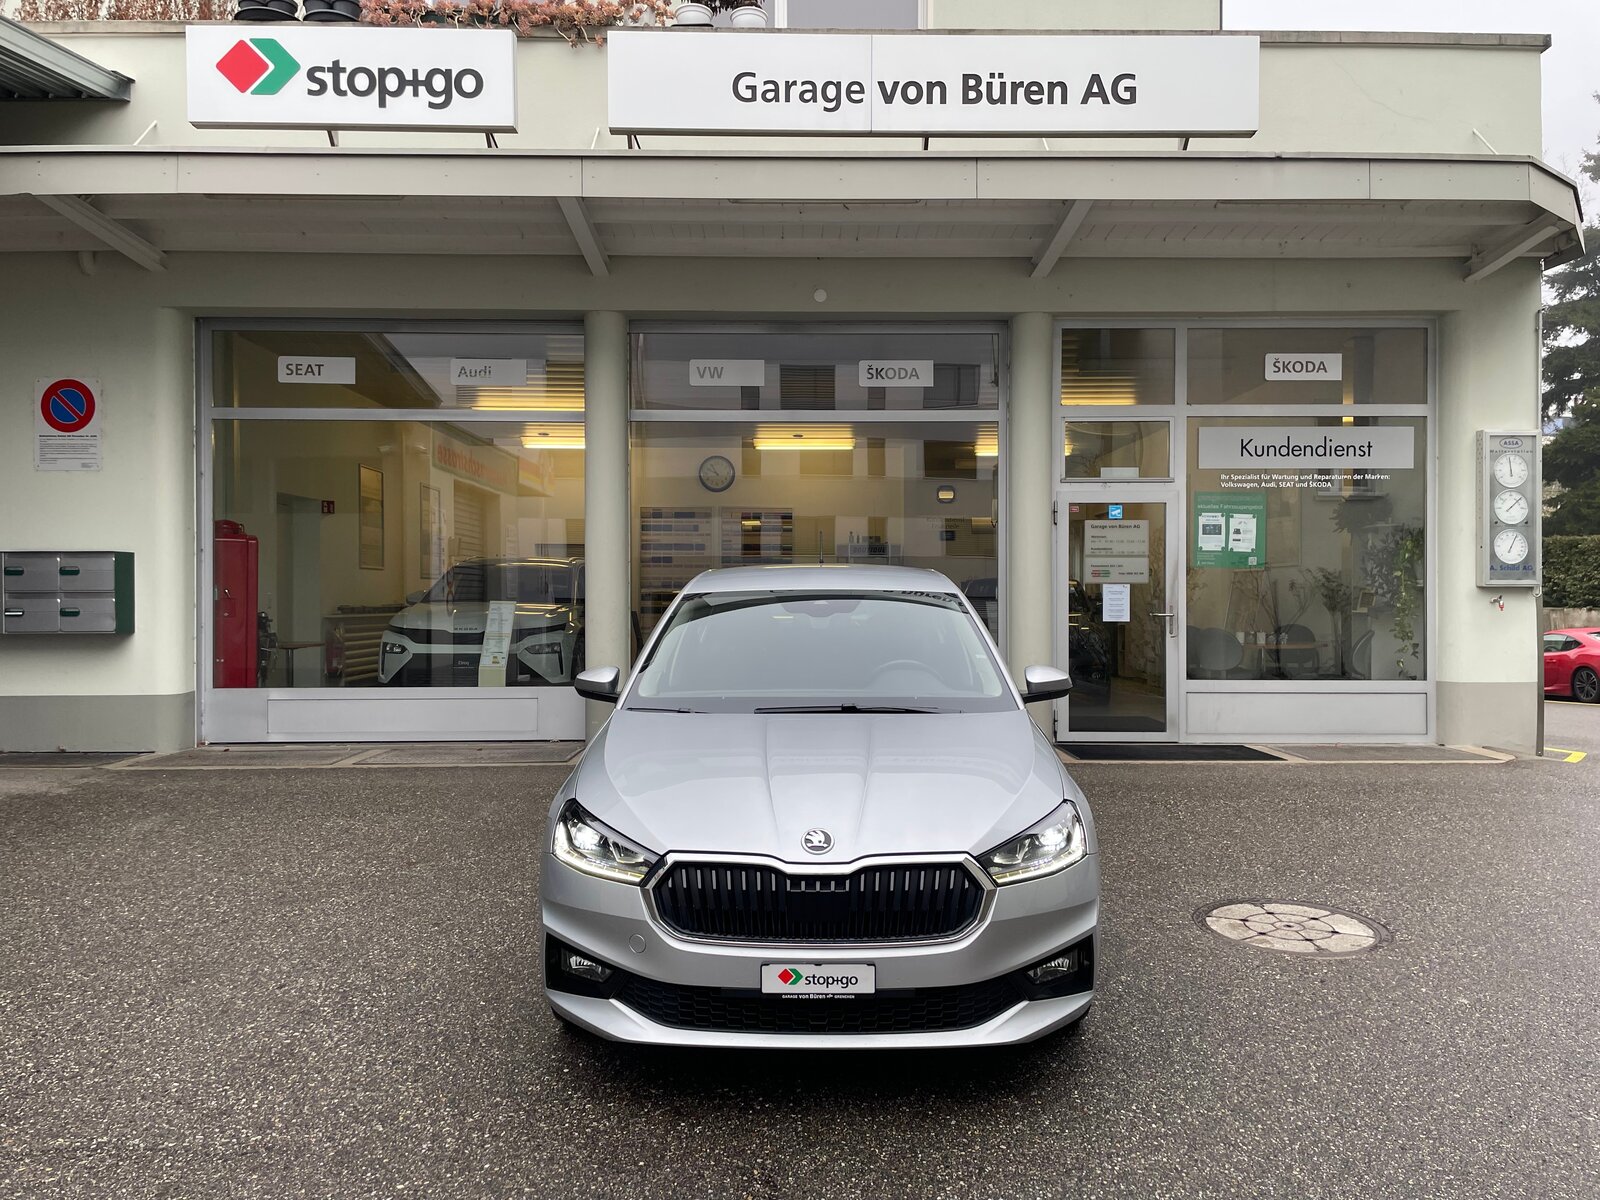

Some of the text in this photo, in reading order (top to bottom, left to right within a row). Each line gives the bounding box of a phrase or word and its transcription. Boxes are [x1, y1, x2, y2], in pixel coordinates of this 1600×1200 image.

[306, 59, 484, 110] stop+go
[731, 71, 1137, 113] Garage von Büren AG
[285, 363, 325, 377] SEAT
[457, 365, 492, 378] Audi
[696, 366, 724, 379] VW
[866, 364, 920, 380] ŠKODA
[1272, 357, 1328, 373] ŠKODA
[1240, 435, 1373, 458] Kundendienst
[1220, 481, 1260, 489] Volkswagen,
[1309, 480, 1332, 488] ŠKODA
[1230, 473, 1260, 481] Spezialist
[1313, 473, 1352, 481] Reparaturen
[804, 973, 859, 989] stop+go
